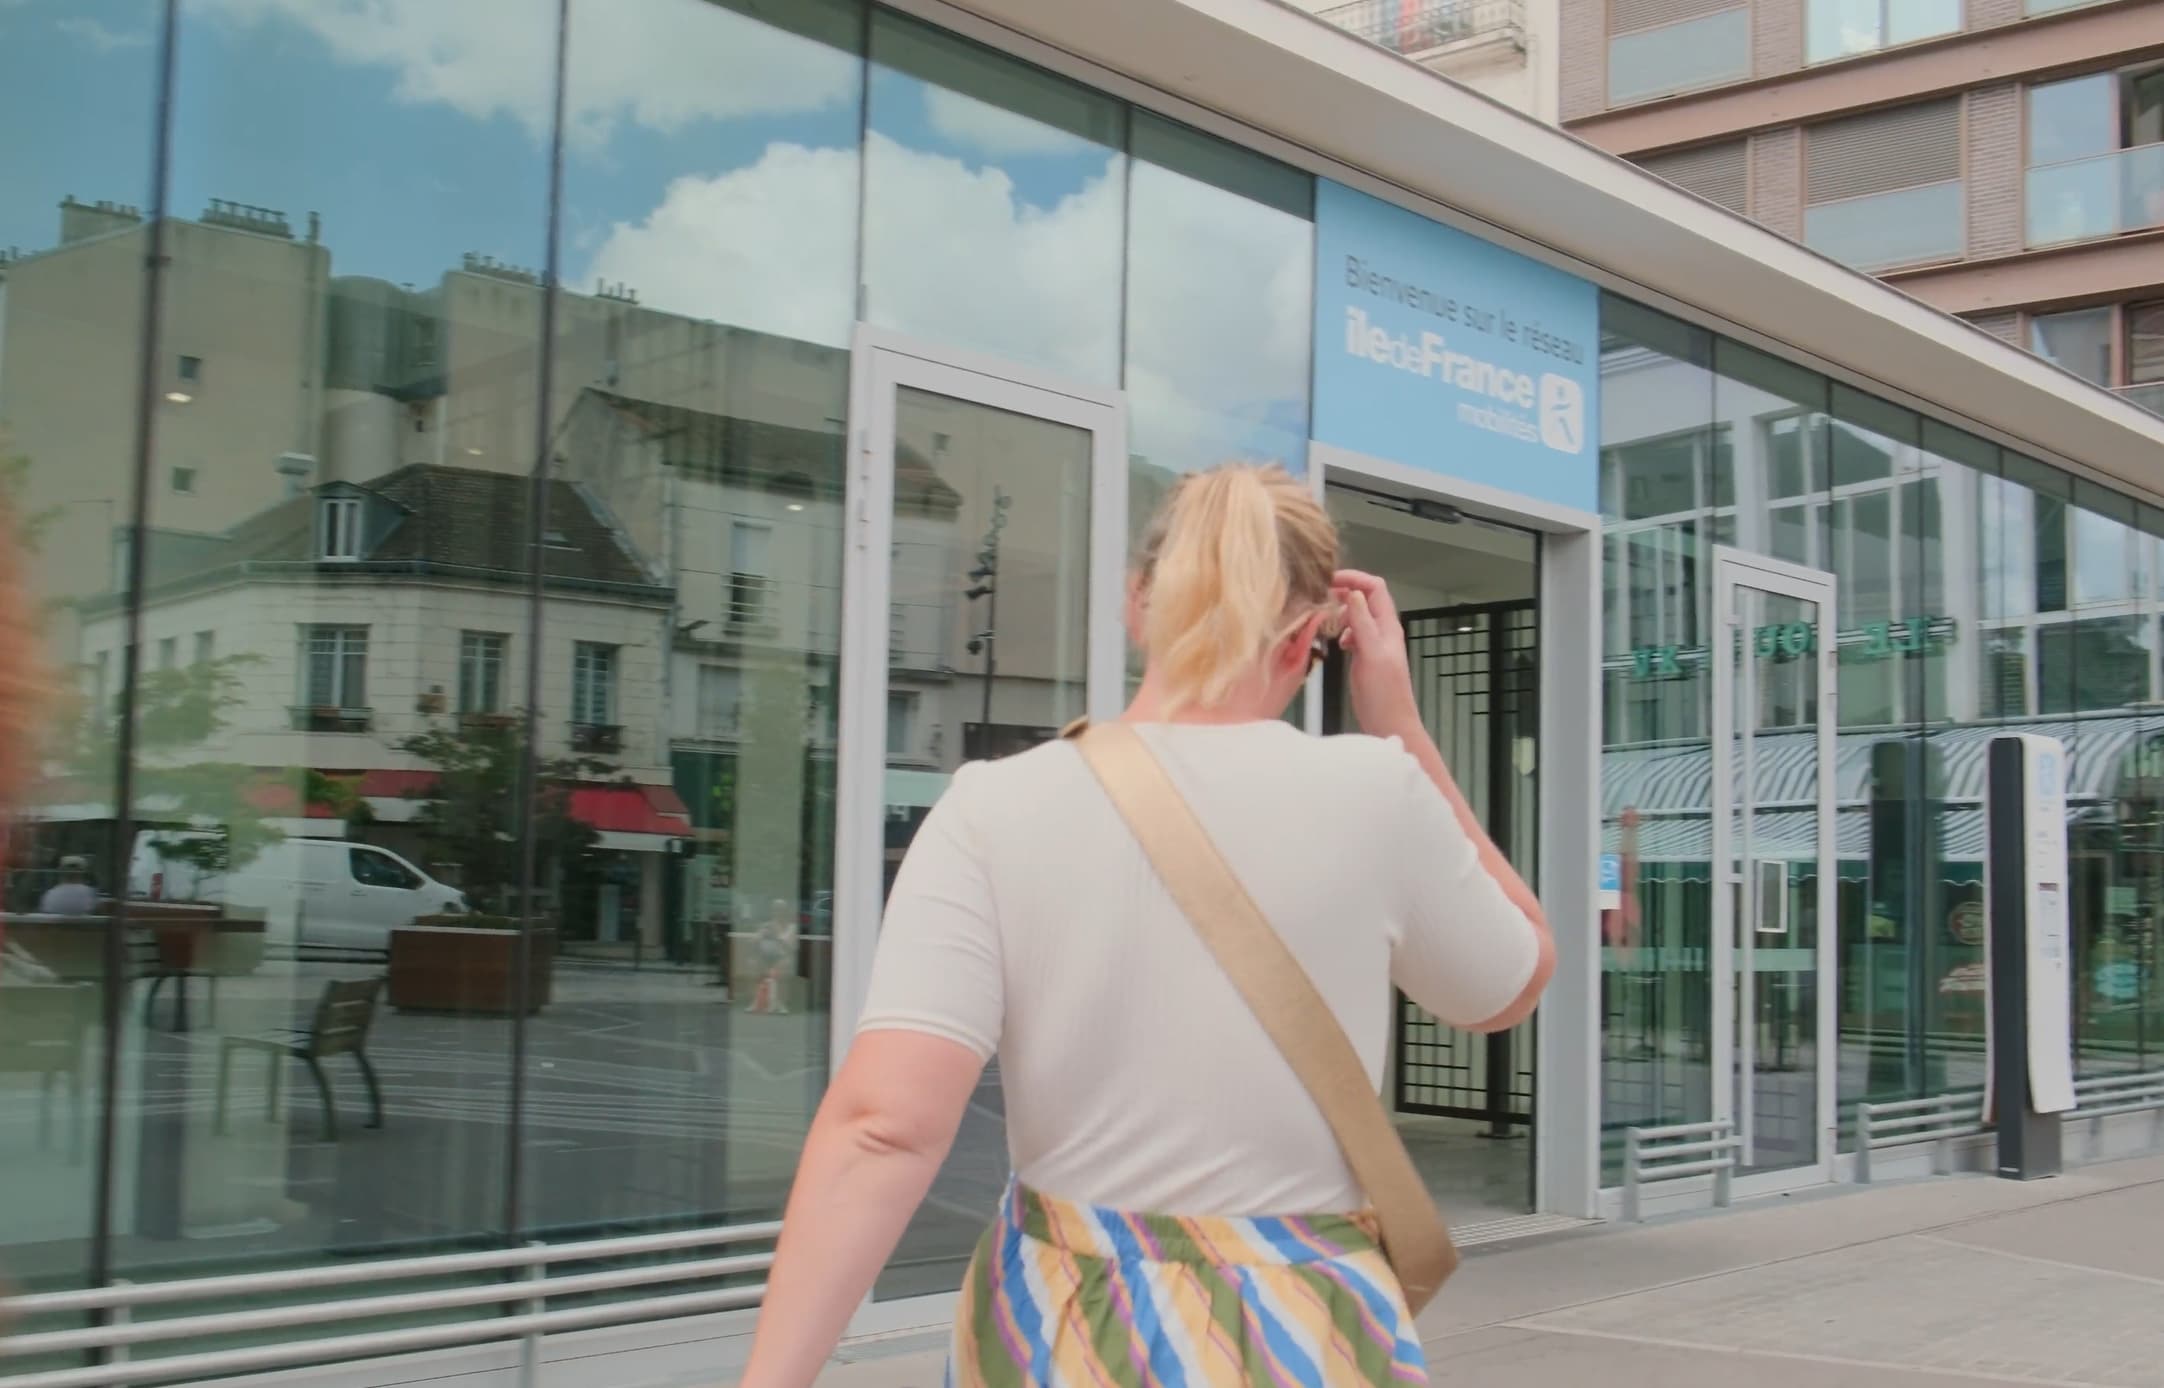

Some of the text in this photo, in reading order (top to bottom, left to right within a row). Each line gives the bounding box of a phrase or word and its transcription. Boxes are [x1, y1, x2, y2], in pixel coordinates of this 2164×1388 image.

[1344, 254, 1584, 366] Bienvenue sur le réseau
